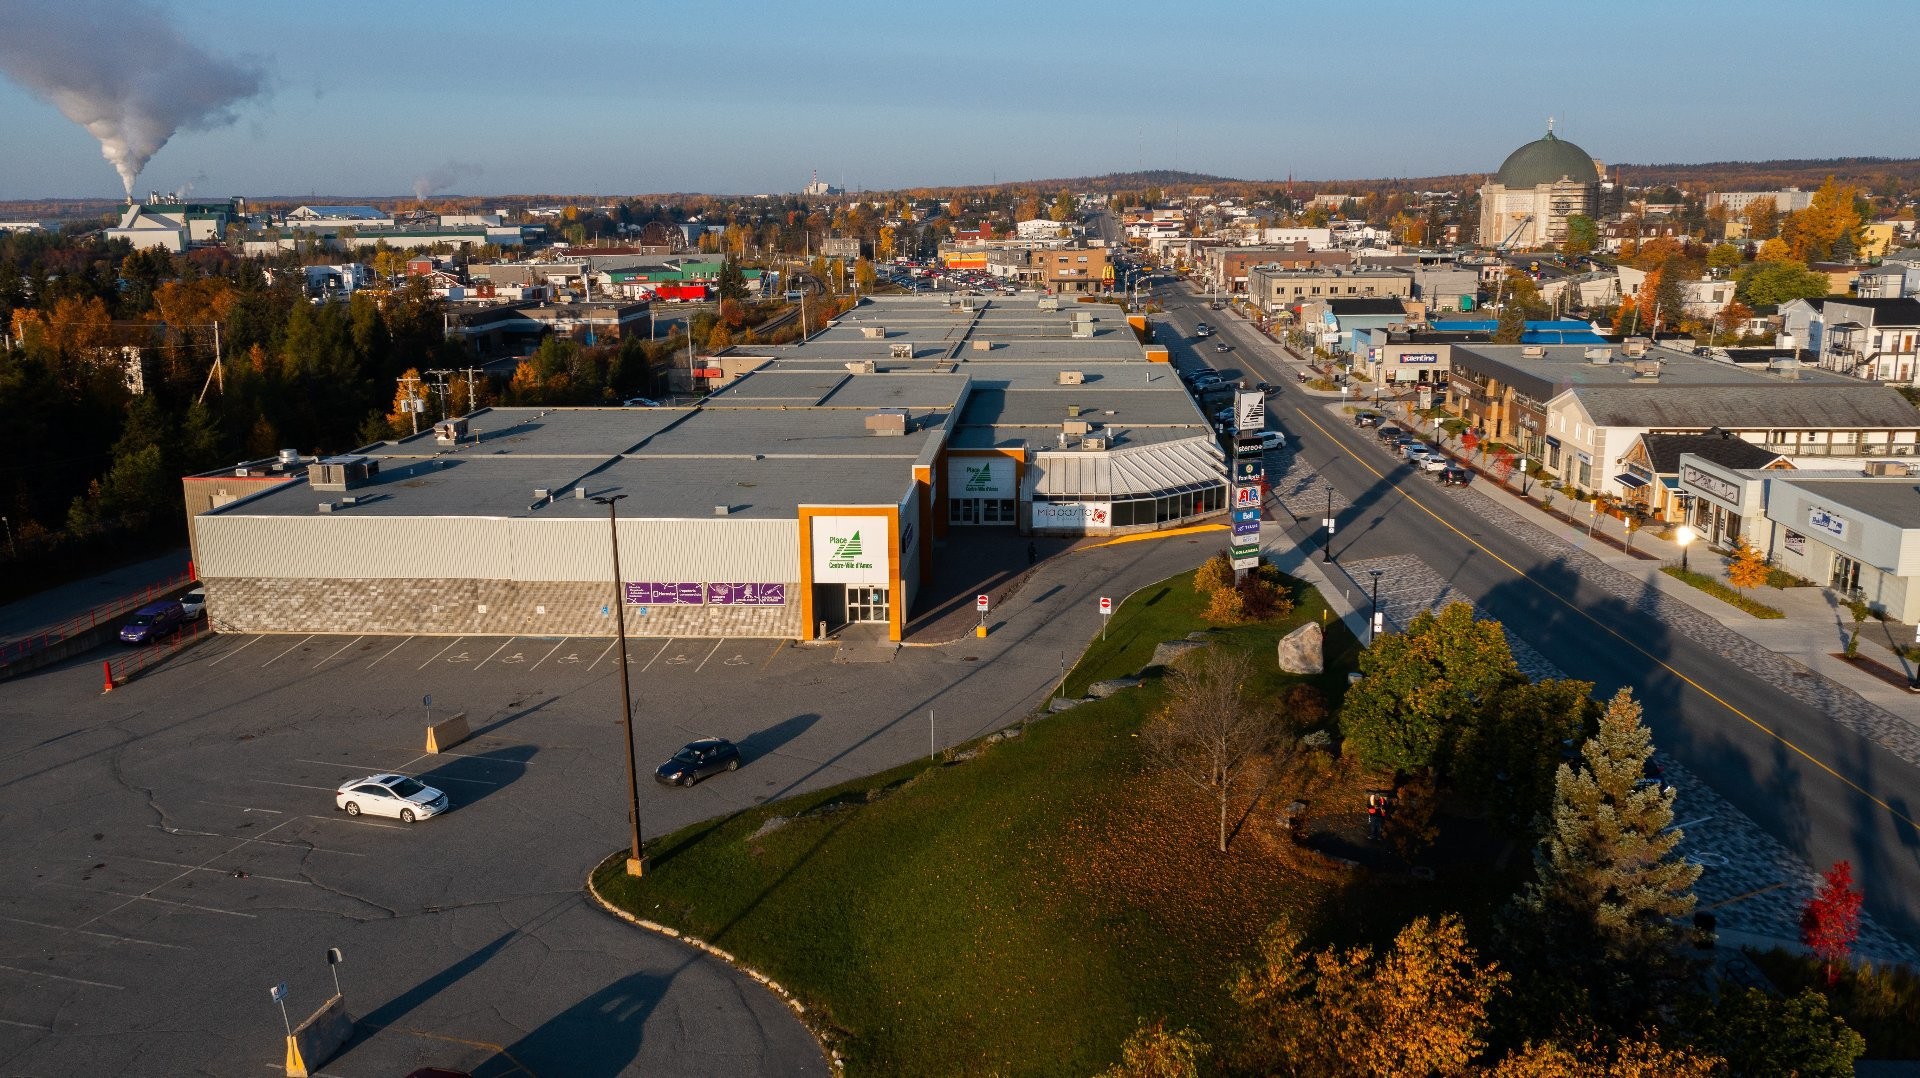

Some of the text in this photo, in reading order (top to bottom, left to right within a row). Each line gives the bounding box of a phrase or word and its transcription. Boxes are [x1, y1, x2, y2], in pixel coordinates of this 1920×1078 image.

[1242, 511, 1254, 520] Bell
[829, 536, 848, 544] Place
[828, 561, 873, 569] Centre-Ville d'Amos
